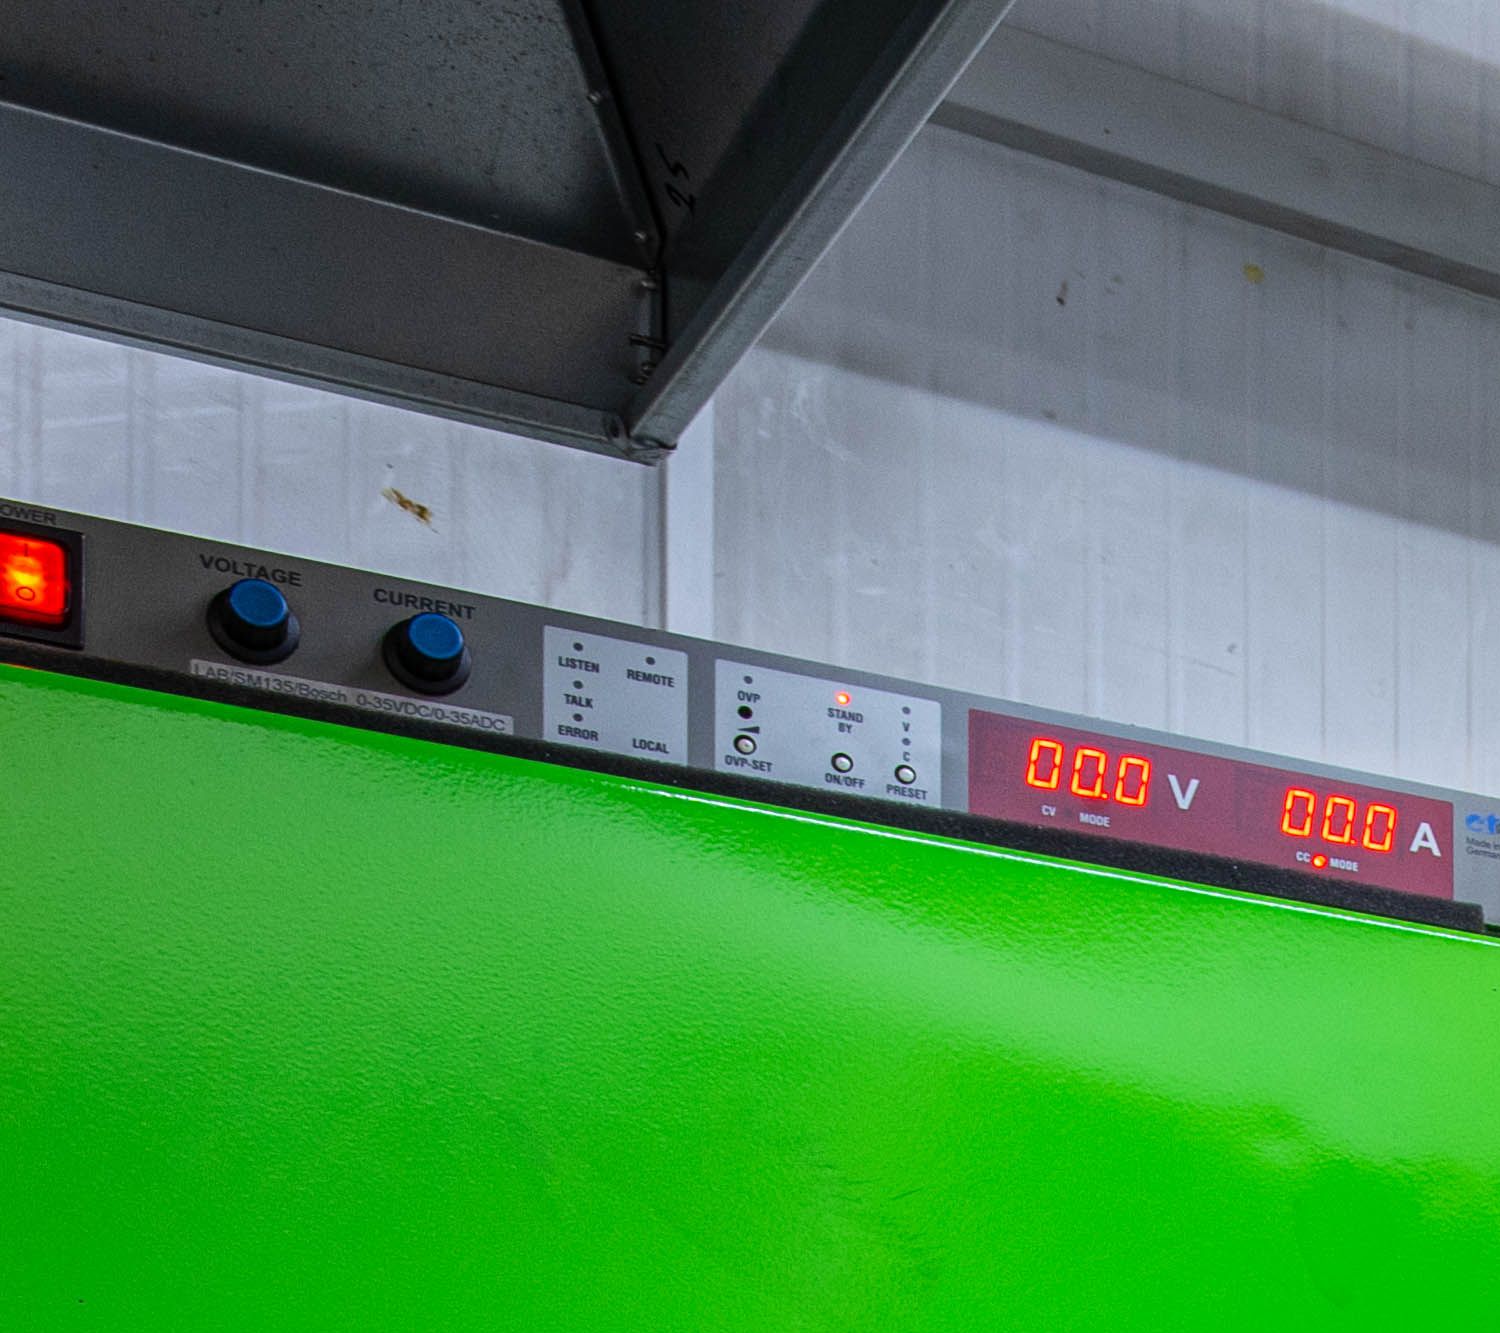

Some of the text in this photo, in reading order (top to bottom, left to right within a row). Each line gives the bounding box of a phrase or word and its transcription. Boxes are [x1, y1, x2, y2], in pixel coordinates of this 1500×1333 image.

[0, 503, 57, 526] OWER
[200, 553, 303, 587] VOLTAGE
[373, 588, 476, 620] CURRENT
[558, 655, 600, 674] LISTEN
[626, 668, 675, 688] REMOTE
[564, 693, 593, 710] TALK
[737, 690, 761, 704] OVP
[827, 706, 864, 724] STAND
[558, 724, 599, 742] ERROR
[838, 721, 853, 735] BY
[632, 738, 670, 755] LOCAL
[725, 754, 773, 774] OVP-SET
[1026, 737, 1151, 807] 00.0
[825, 772, 866, 790] ON/OFF
[886, 784, 929, 801] PRESET
[1168, 774, 1199, 810] V
[1041, 804, 1111, 828] CV MODE
[1281, 788, 1397, 853] 00.0
[1410, 821, 1441, 857] A
[1296, 851, 1360, 872] CC MODE
